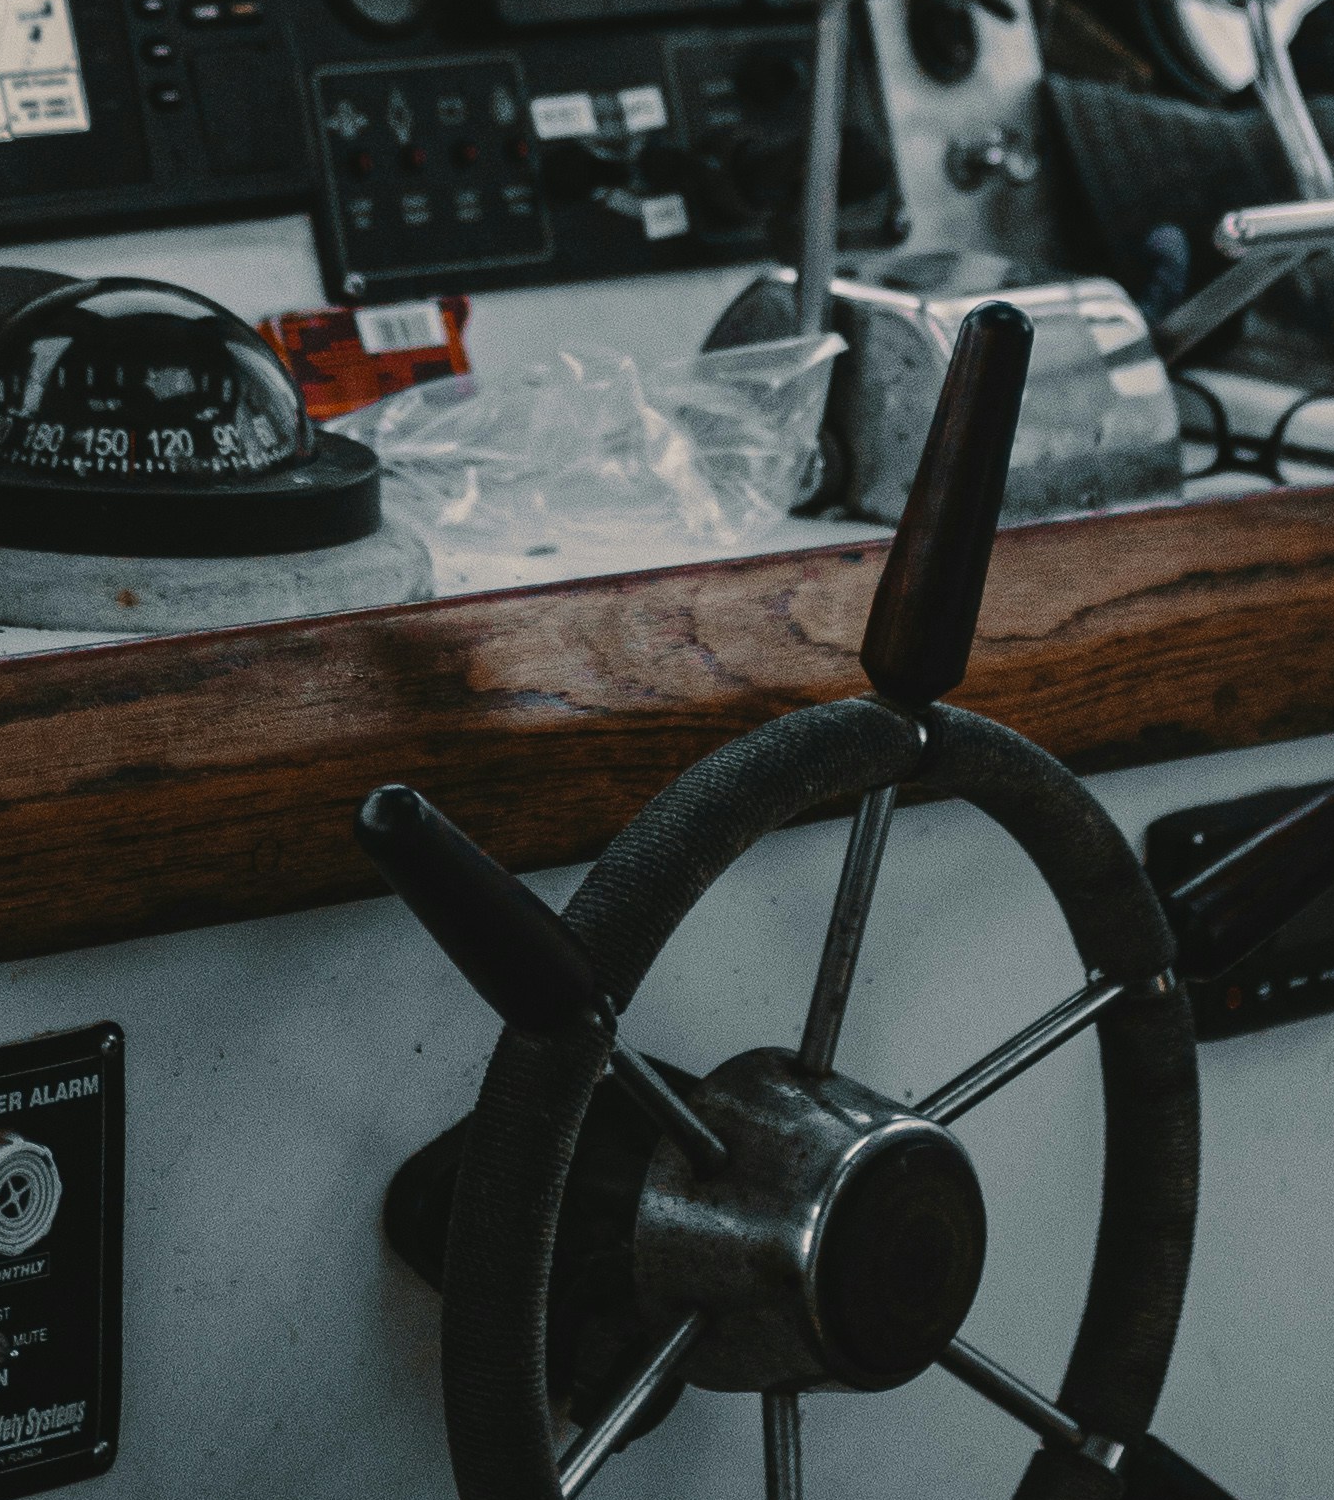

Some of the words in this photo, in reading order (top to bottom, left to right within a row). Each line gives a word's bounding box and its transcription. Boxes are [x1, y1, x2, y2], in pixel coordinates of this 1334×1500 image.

[23, 421, 65, 452] 180
[82, 427, 129, 457] 150
[148, 427, 194, 458] 120
[29, 1073, 100, 1108] ALARM
[12, 1327, 48, 1347] MUTE
[25, 1400, 86, 1439] Systems
